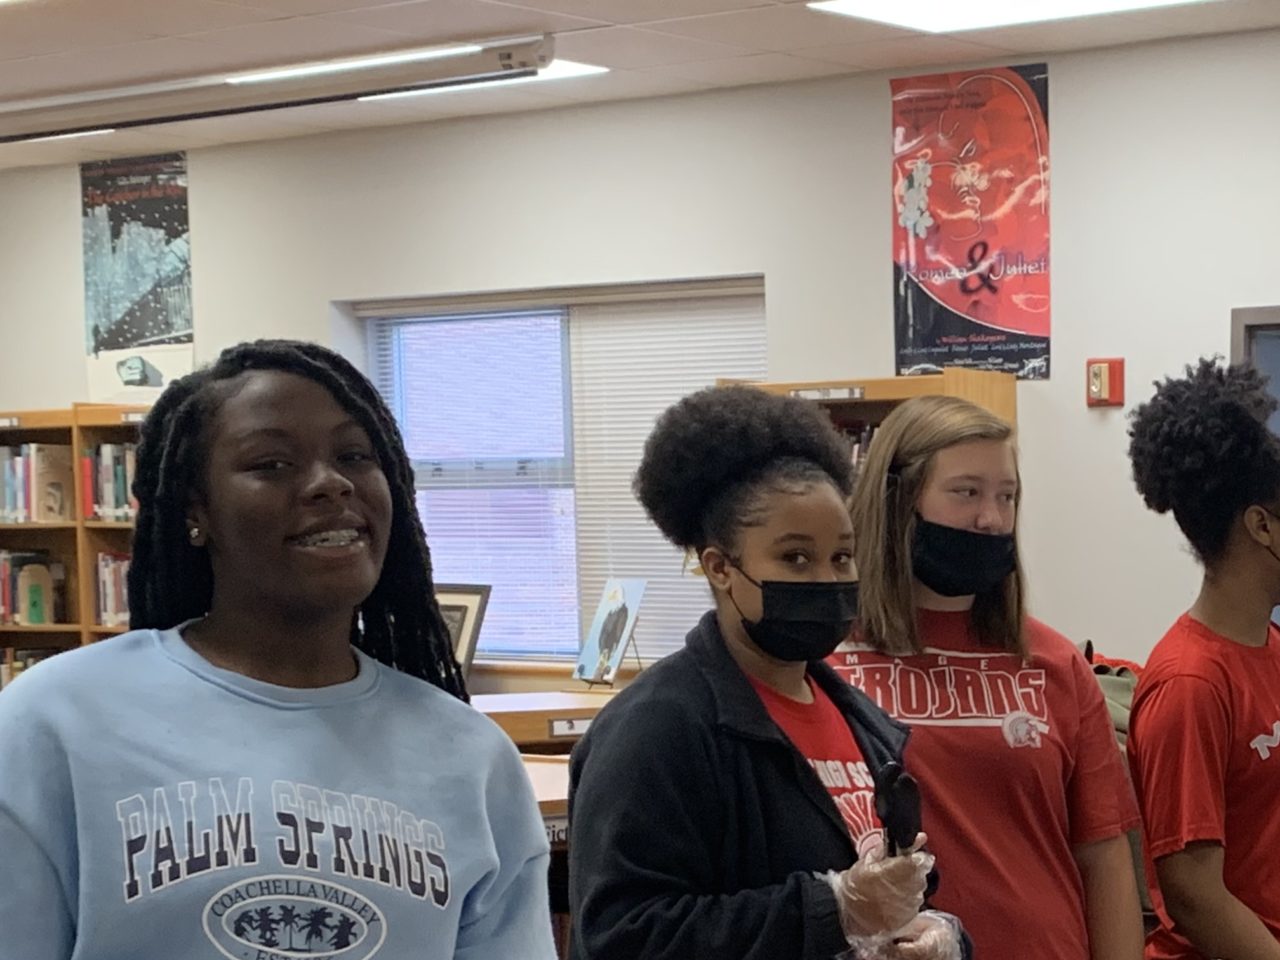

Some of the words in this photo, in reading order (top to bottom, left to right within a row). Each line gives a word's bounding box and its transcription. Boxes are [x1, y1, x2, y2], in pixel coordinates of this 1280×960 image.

[959, 241, 998, 294] &
[988, 250, 1048, 280] Juliet
[116, 777, 258, 903] PALM
[271, 779, 451, 910] SPRINGS
[211, 881, 318, 918] COACHELLA
[321, 884, 381, 927] VALLEY
